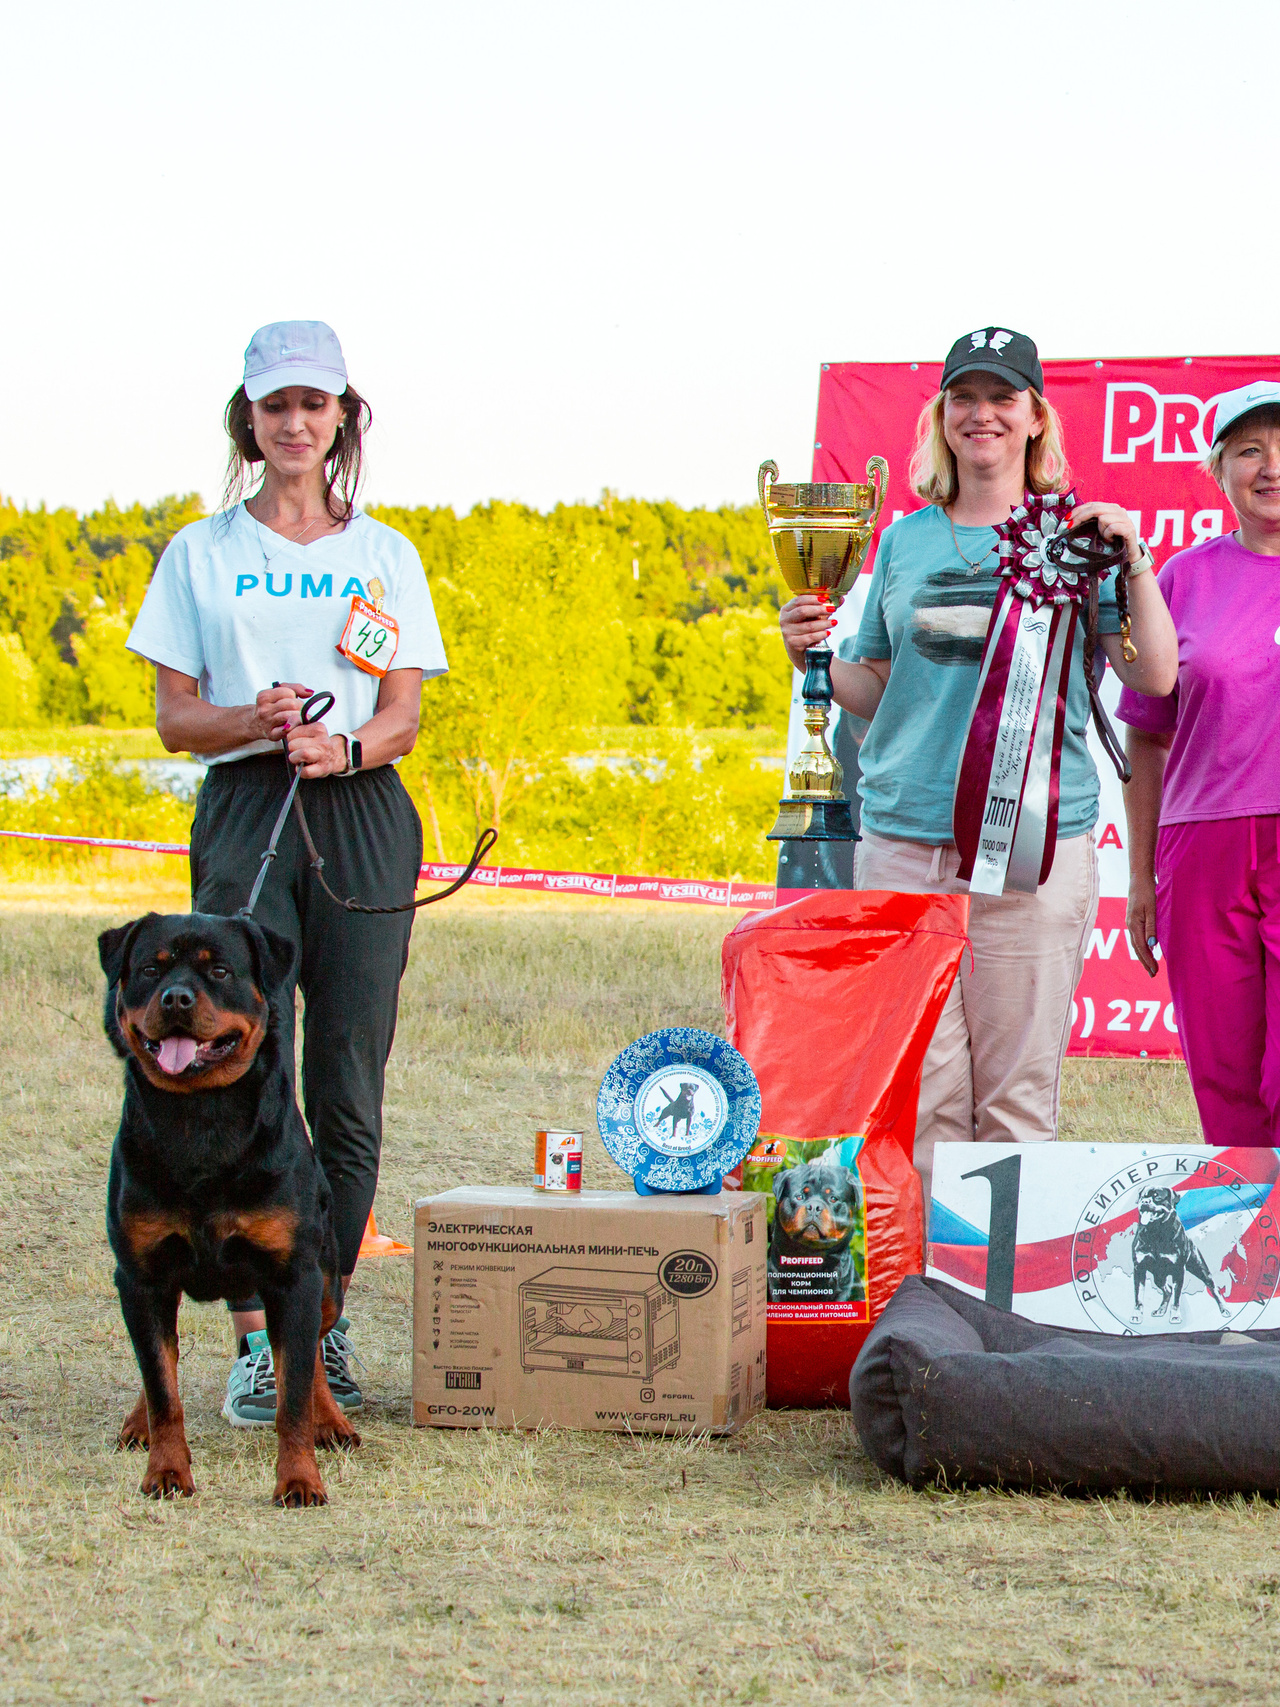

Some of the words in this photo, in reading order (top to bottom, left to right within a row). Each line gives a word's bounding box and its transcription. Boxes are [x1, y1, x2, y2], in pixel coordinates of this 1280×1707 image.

[235, 573, 368, 601] PUMA
[356, 621, 388, 658] 49
[546, 875, 611, 892] ТРАПЕЗА
[661, 885, 728, 902] ТРАПЕЗА
[1078, 1160, 1159, 1302] РОТВЕЙЛЕР
[1174, 1158, 1244, 1192] КЛУБ
[1247, 1196, 1280, 1307] РОССИИ
[427, 1240, 586, 1256] МНОГОФУНКЦИОНАЛЬНАЯ
[588, 1245, 660, 1258] МИНИ-ПЕЧЬ
[476, 1265, 516, 1273] КОНВЕКЦИИ
[781, 1256, 824, 1265] PROFIFEED
[767, 1271, 838, 1279] ПОЛНОРАЦИОННЫЙ
[427, 1404, 495, 1416] GFO-20W
[595, 1410, 696, 1422] WWW.GFGRIL.RU
